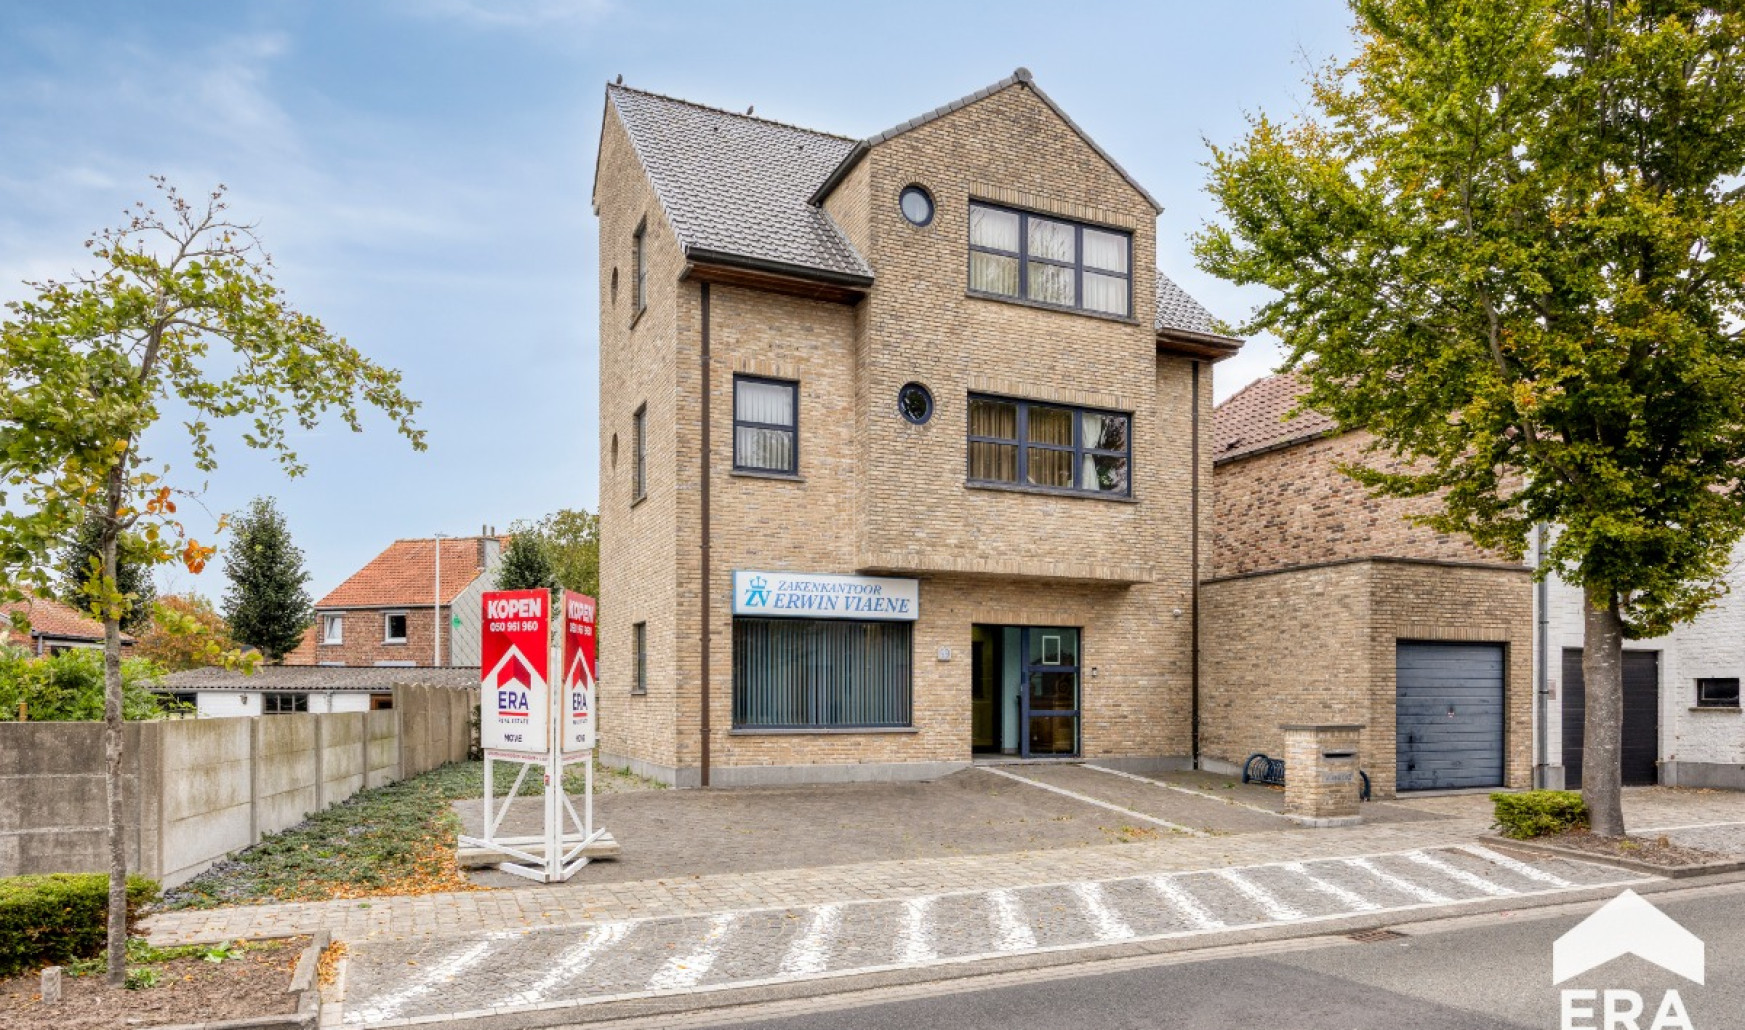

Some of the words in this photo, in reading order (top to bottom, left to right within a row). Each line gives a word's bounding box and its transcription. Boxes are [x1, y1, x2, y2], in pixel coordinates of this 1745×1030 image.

[778, 580, 882, 595] ZAKENKANTOOR
[487, 597, 542, 619] KOPEN
[568, 599, 594, 623] KOPEN
[773, 593, 839, 610] ERWIN
[844, 596, 910, 613] VIAENE
[489, 622, 506, 632] 050
[521, 620, 539, 632] 960
[498, 690, 529, 710] ERA
[572, 692, 588, 711] ERA
